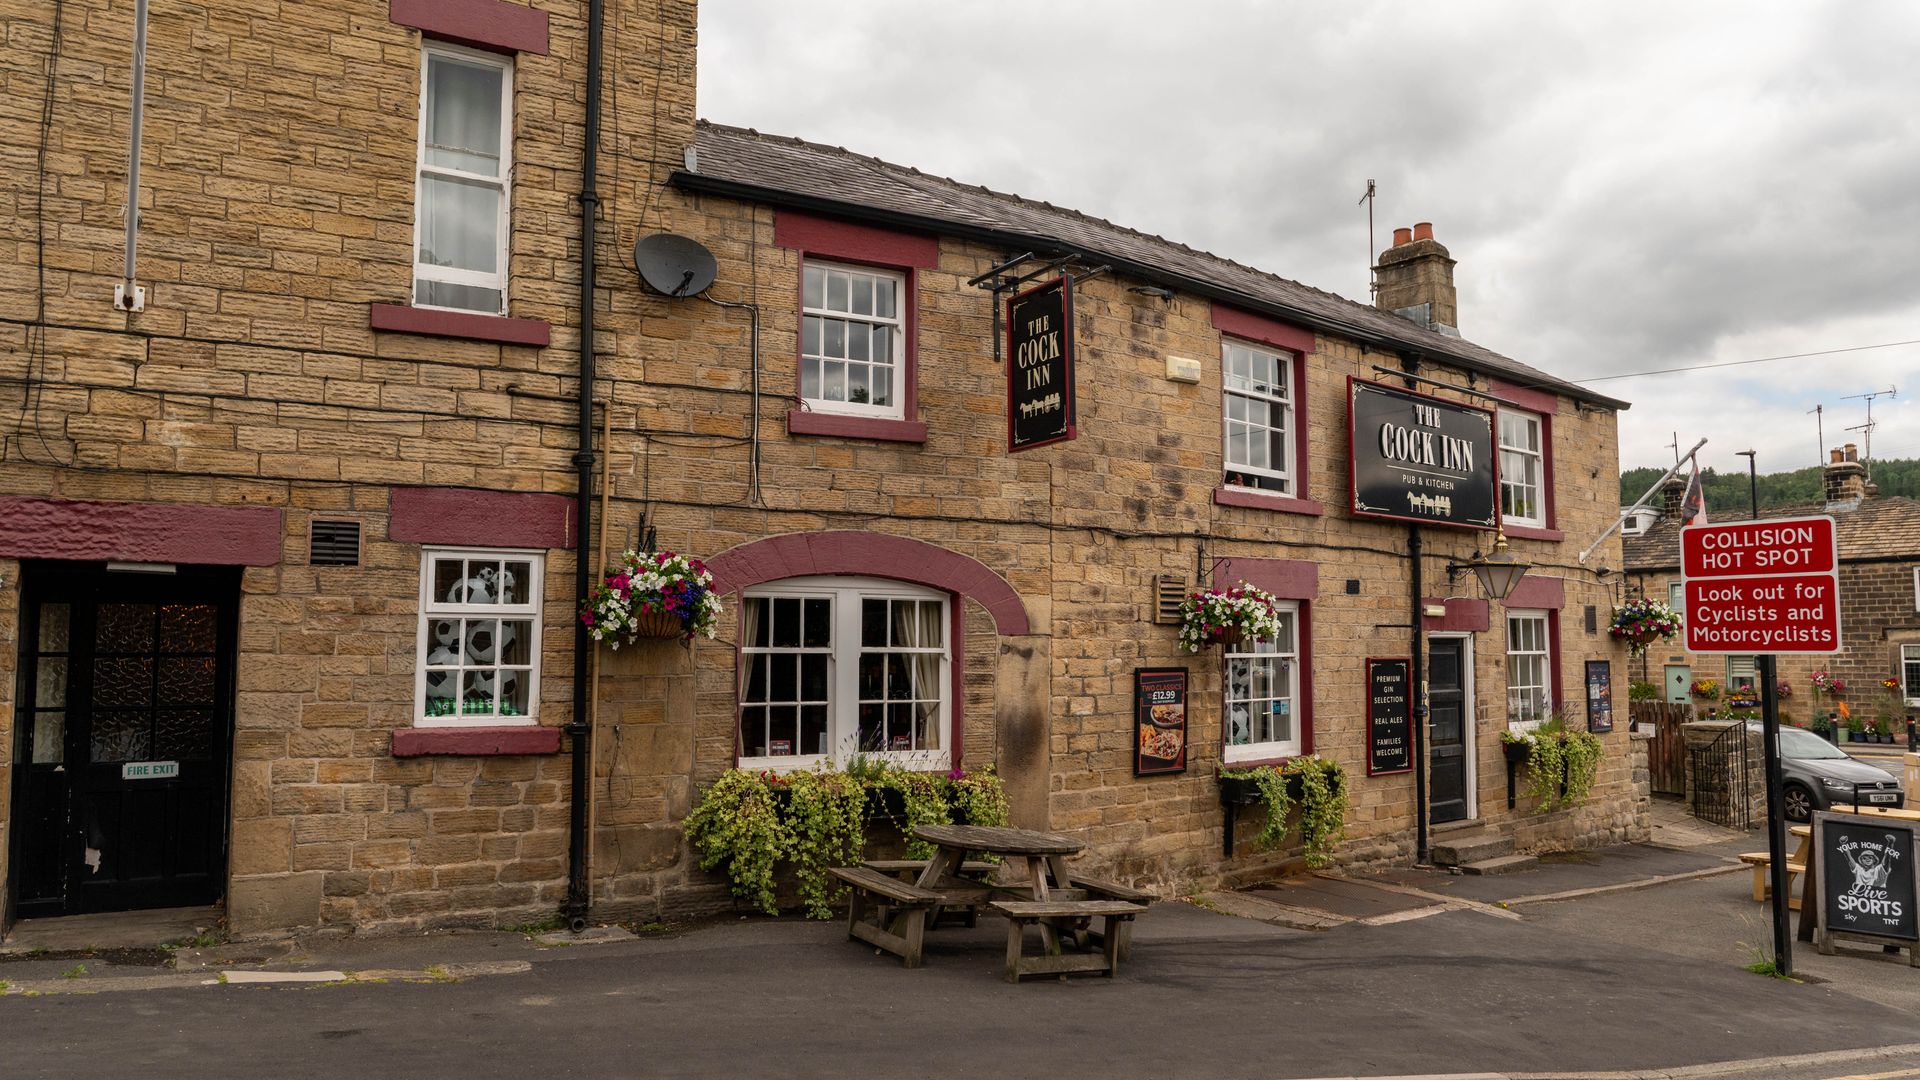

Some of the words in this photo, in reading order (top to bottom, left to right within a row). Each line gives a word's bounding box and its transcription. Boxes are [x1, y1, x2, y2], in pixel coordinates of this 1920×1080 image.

[1027, 314, 1049, 337] THE
[1018, 331, 1060, 369] COCK
[1027, 363, 1050, 391] INN
[1415, 404, 1441, 428] THE
[1381, 422, 1436, 466] COCK
[1442, 434, 1474, 473] INN
[1402, 474, 1415, 483] PUB
[1418, 476, 1422, 485] &
[1425, 478, 1454, 489] KITCHEN
[1702, 526, 1813, 549] COLLISION
[1702, 551, 1745, 569] HOT
[1755, 548, 1813, 567] SPOT
[1698, 585, 1743, 602] Look
[1752, 584, 1785, 600] out
[1794, 583, 1825, 599] for
[1697, 605, 1778, 625] Cyclists
[1787, 604, 1824, 621] and
[1693, 625, 1832, 645] Motorcyclists
[1152, 690, 1175, 699] £12.99
[1376, 748, 1402, 756] WELCOME
[127, 766, 148, 775] FIRE
[153, 764, 175, 774] EXIT
[1836, 842, 1858, 852] YOUR
[1860, 842, 1882, 851] HOME
[1884, 846, 1899, 859] FOR
[1847, 881, 1888, 900] Live
[1837, 894, 1903, 917] SPORTS
